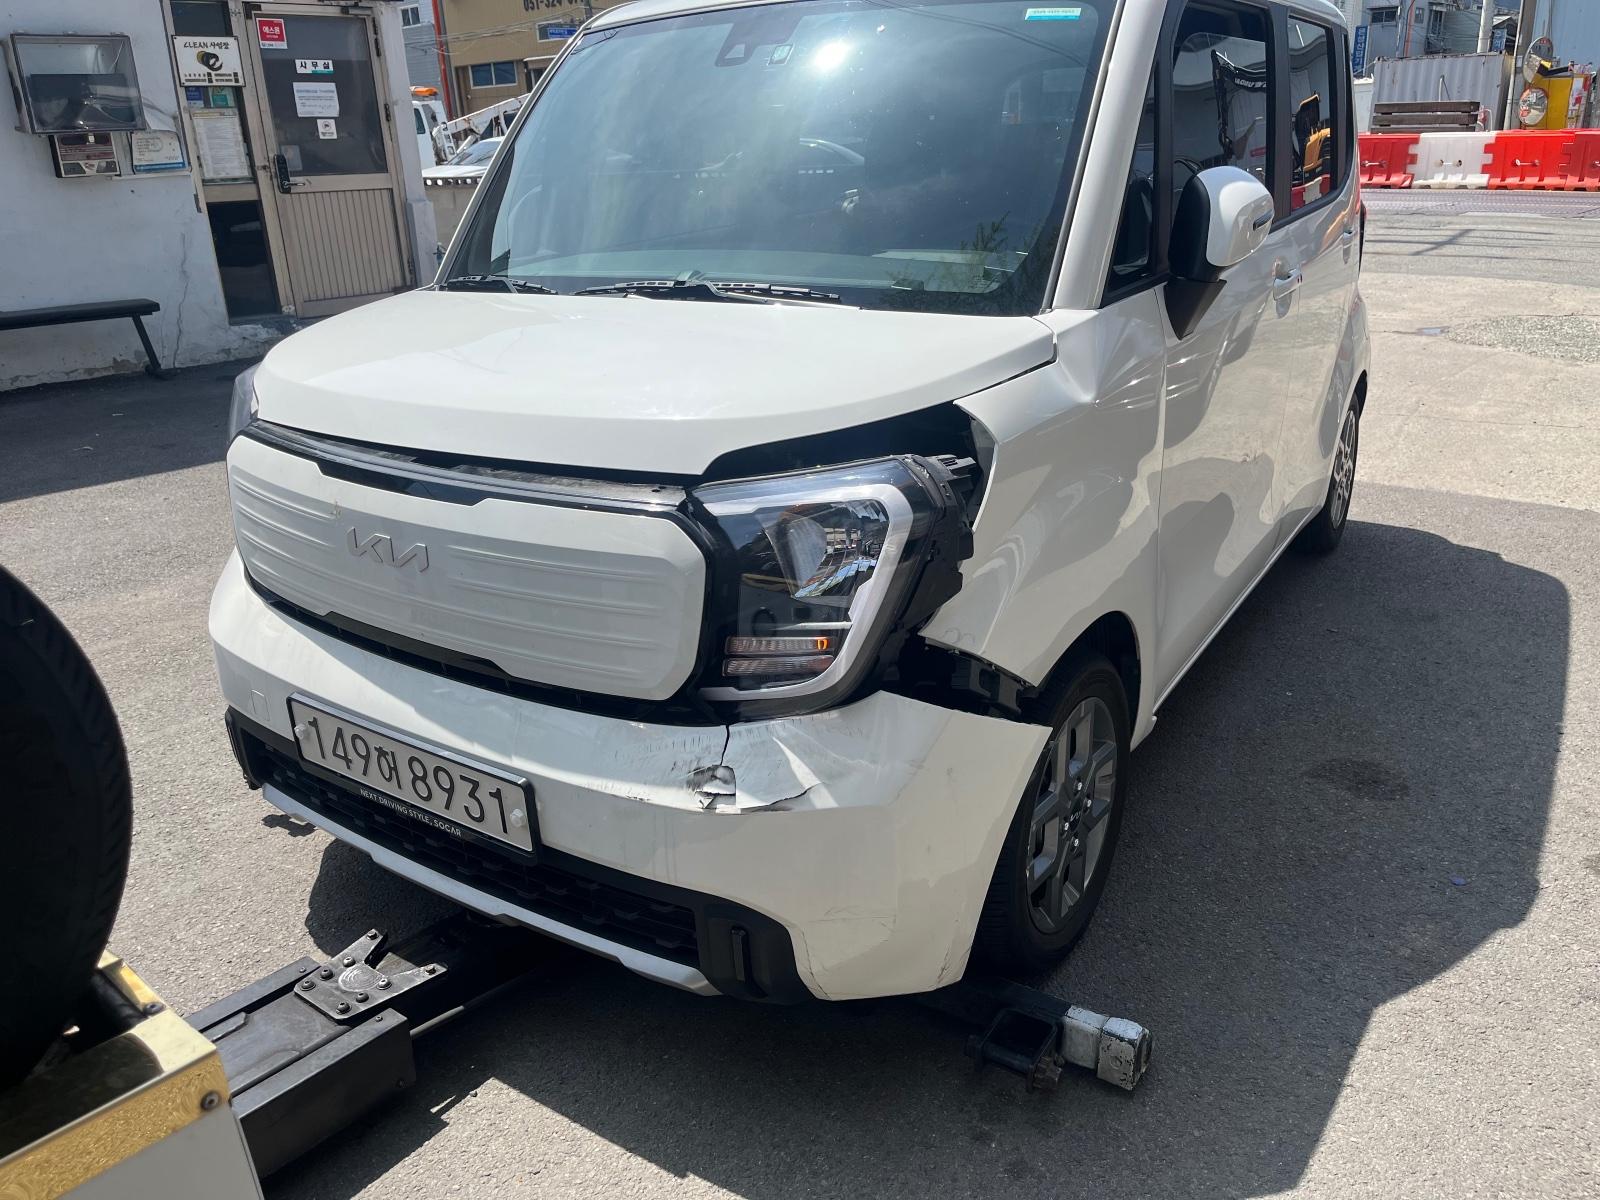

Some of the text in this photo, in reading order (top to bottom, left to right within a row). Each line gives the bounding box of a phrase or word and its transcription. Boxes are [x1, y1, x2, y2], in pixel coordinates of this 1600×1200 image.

[183, 41, 208, 49] CLEAN
[300, 61, 330, 70] 사무실
[346, 526, 429, 573] KIA
[360, 788, 377, 801] NEXT
[379, 796, 408, 814] DRIVING
[433, 819, 462, 837] SOCAR
